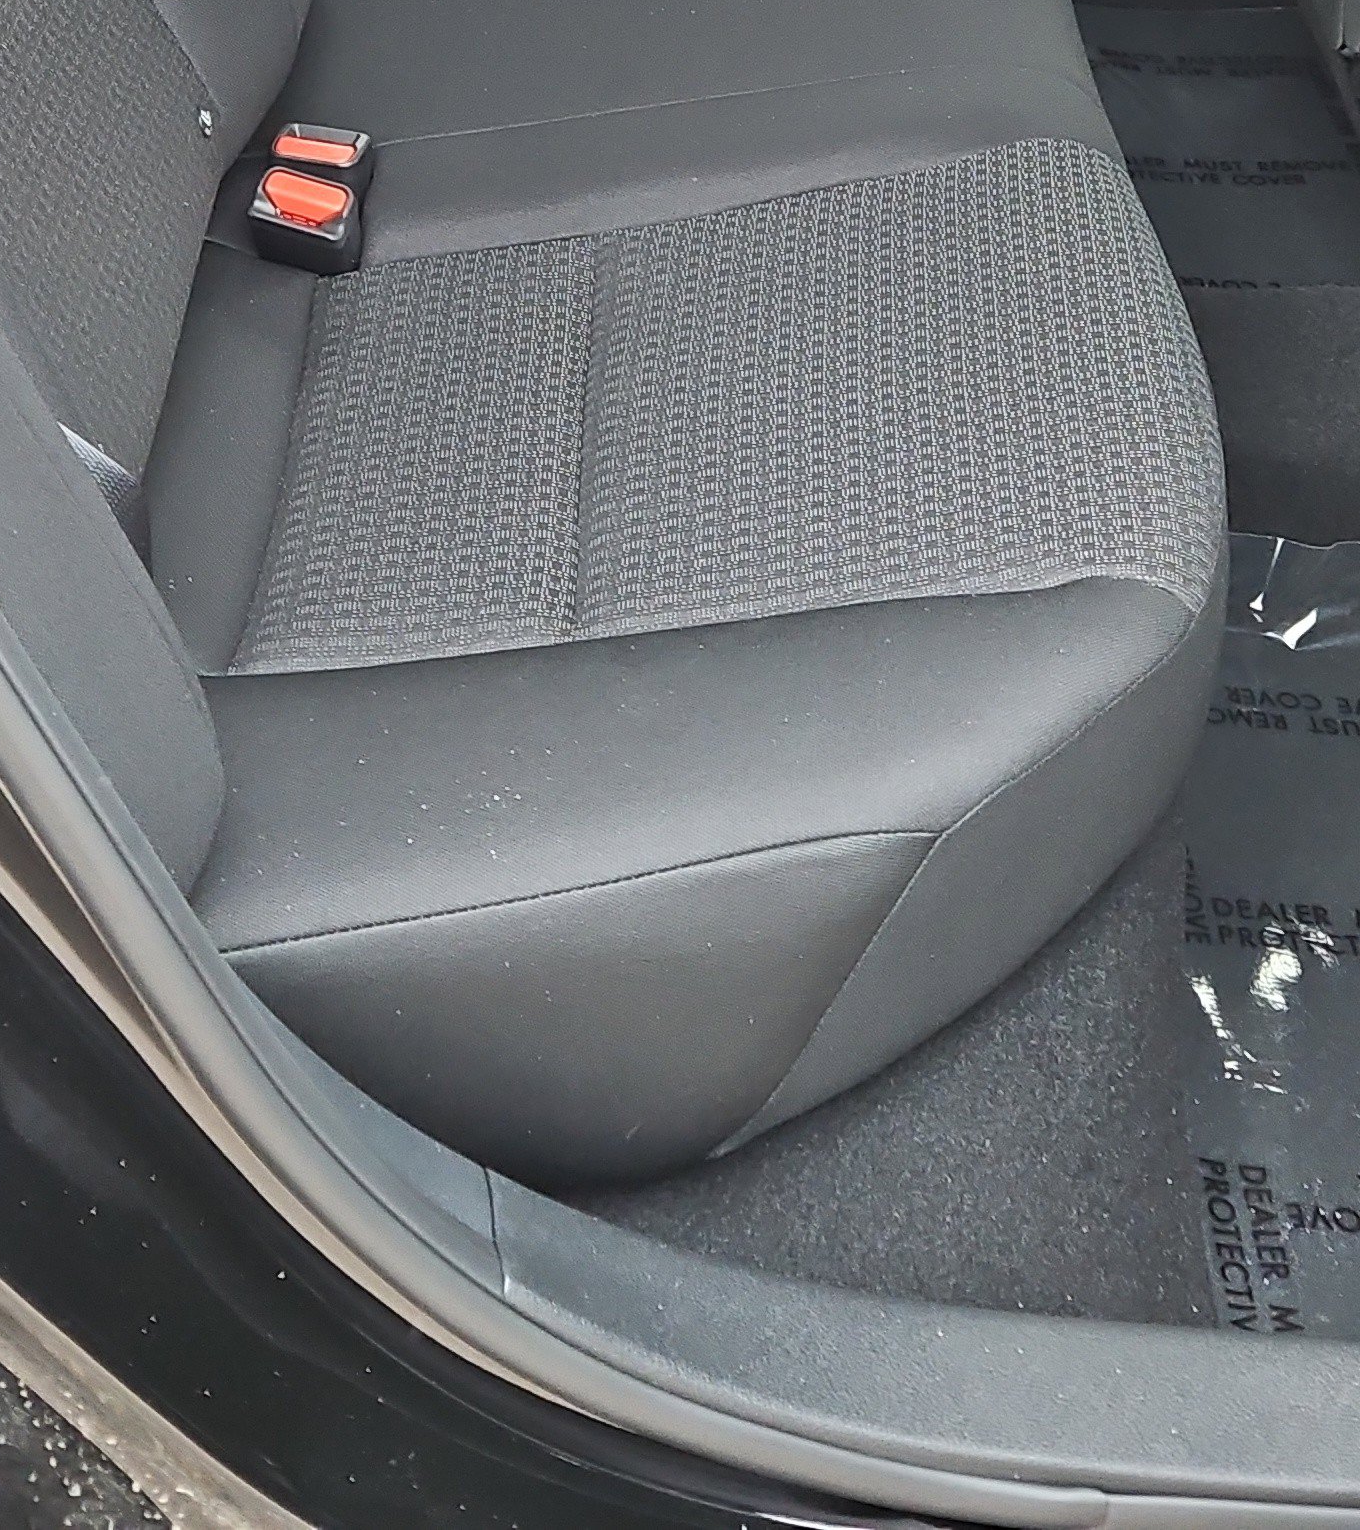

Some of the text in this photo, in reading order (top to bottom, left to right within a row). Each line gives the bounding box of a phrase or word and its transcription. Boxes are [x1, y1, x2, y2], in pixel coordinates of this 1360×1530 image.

[1226, 685, 1322, 710] COVER
[1211, 896, 1332, 926] DEALER
[1238, 1164, 1291, 1280] DEALER
